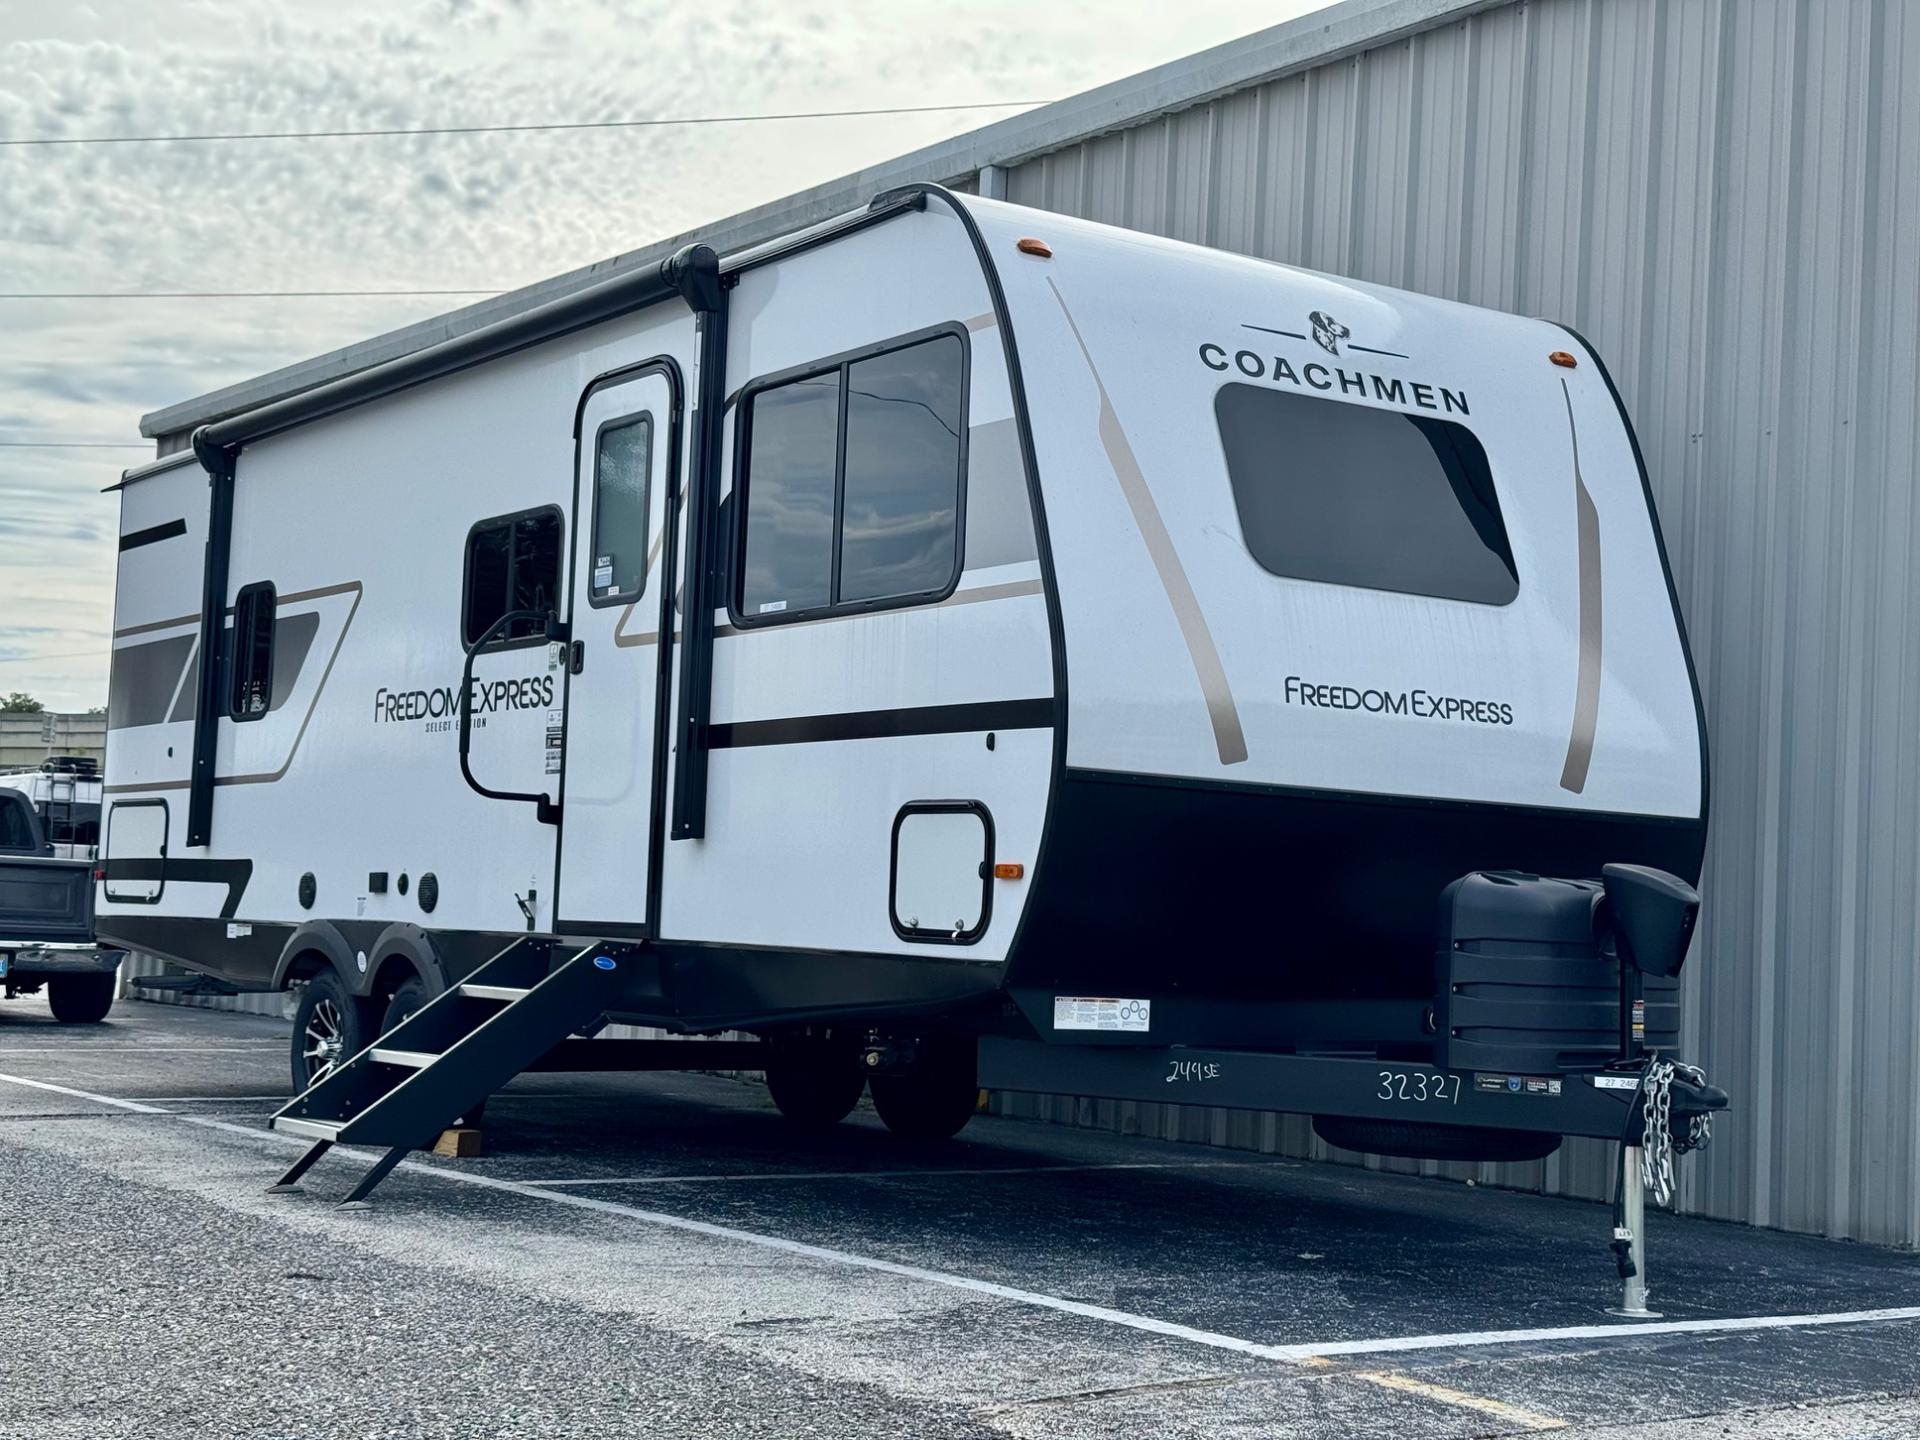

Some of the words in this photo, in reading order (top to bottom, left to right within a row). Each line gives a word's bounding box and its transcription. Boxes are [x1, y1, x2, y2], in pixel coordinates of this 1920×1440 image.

[1198, 343, 1471, 416] COACHMEN
[455, 717, 487, 731] EION
[1165, 1060, 1221, 1083] 249SE
[1377, 1071, 1461, 1105] 32327
